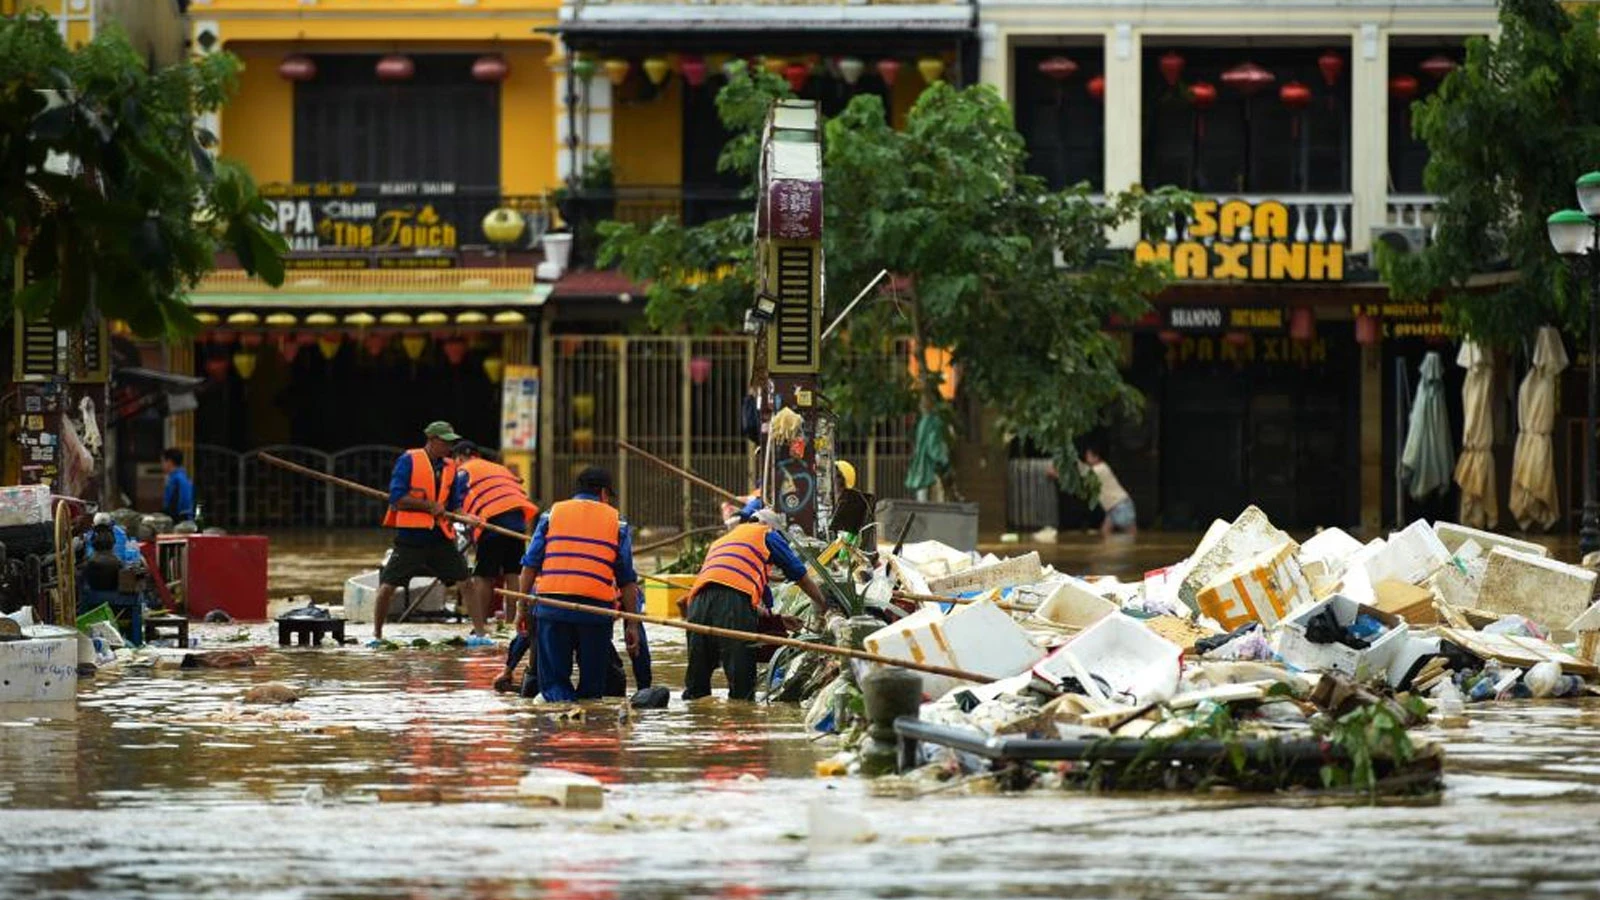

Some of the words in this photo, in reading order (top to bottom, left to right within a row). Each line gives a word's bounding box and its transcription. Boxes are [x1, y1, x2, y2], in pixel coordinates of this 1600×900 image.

[259, 200, 315, 234] SPA
[333, 222, 373, 248] The
[379, 206, 456, 248] Touch
[1188, 200, 1289, 239] SPA
[1171, 308, 1222, 328] SHAMPOO
